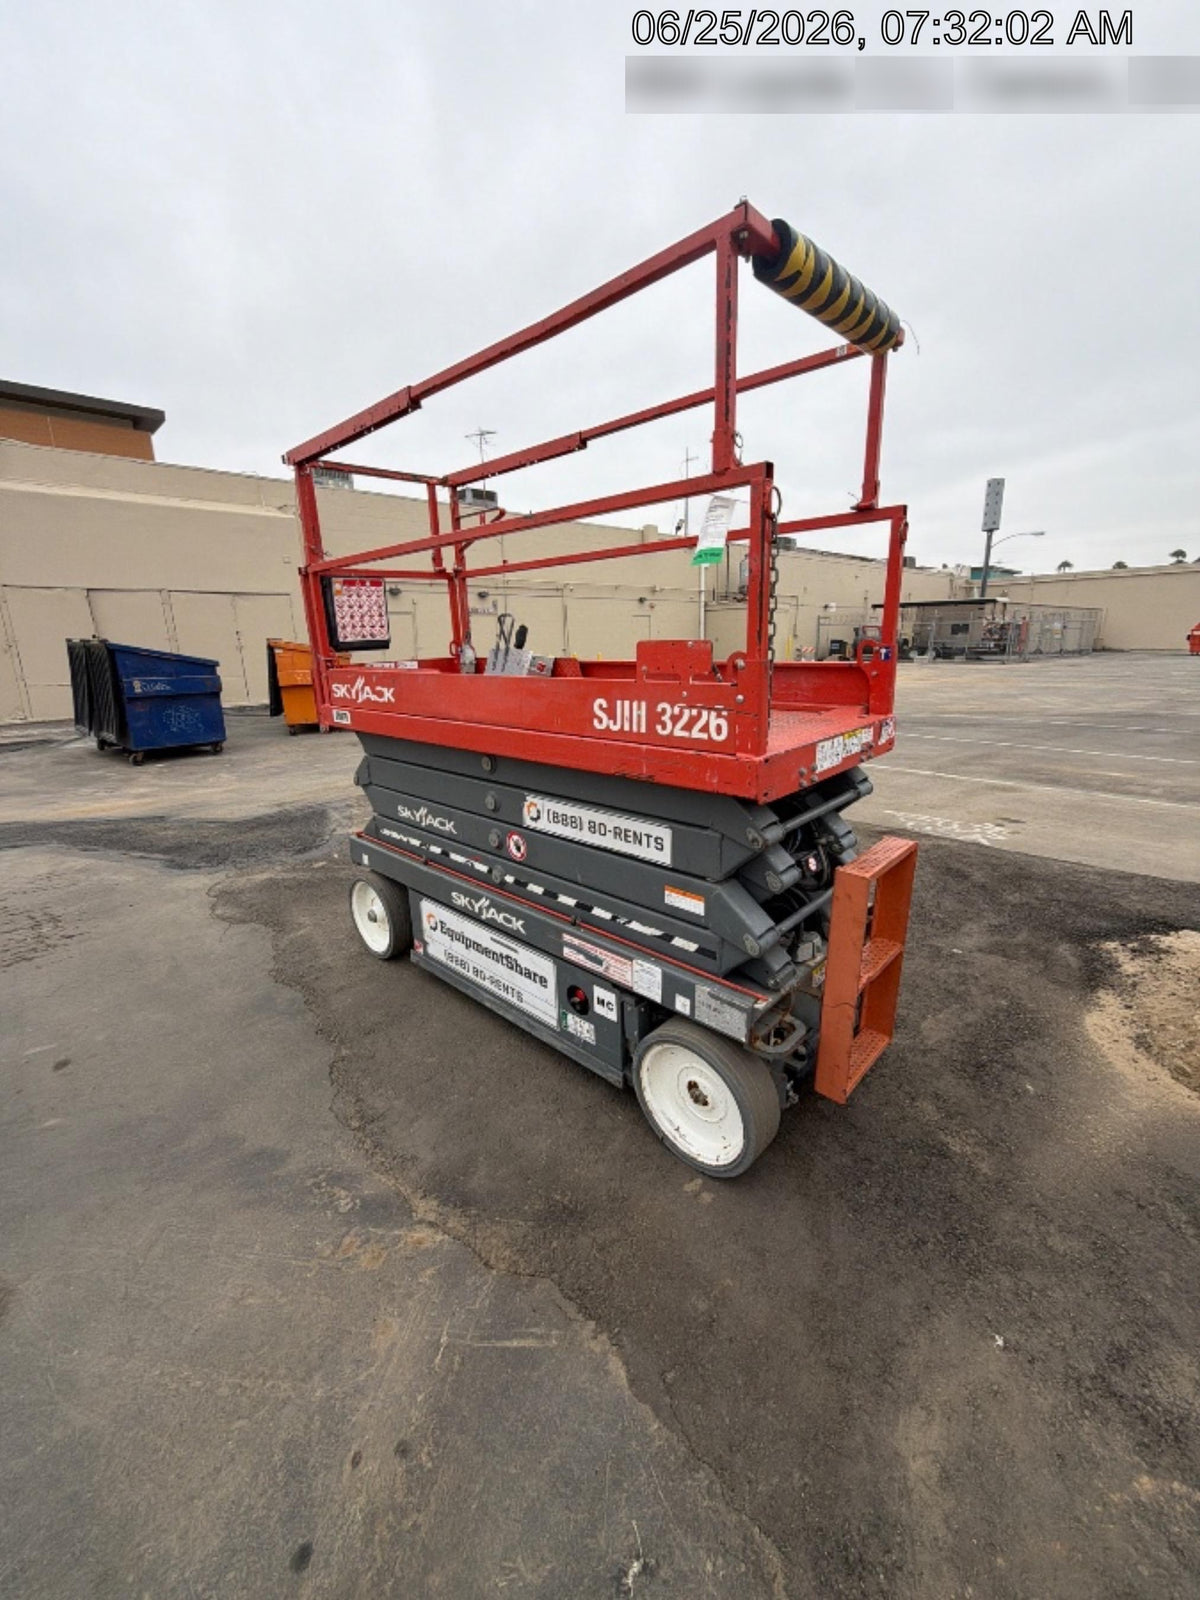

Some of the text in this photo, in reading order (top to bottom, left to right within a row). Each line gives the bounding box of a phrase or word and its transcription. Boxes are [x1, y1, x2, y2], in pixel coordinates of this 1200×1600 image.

[331, 675, 396, 703] SKYJACK
[655, 702, 728, 741] 3226
[397, 804, 458, 834] SKYJACK
[588, 820, 664, 852] 80-RENTS
[451, 891, 527, 936] SKYJACK
[439, 920, 549, 989] EquipmentShare
